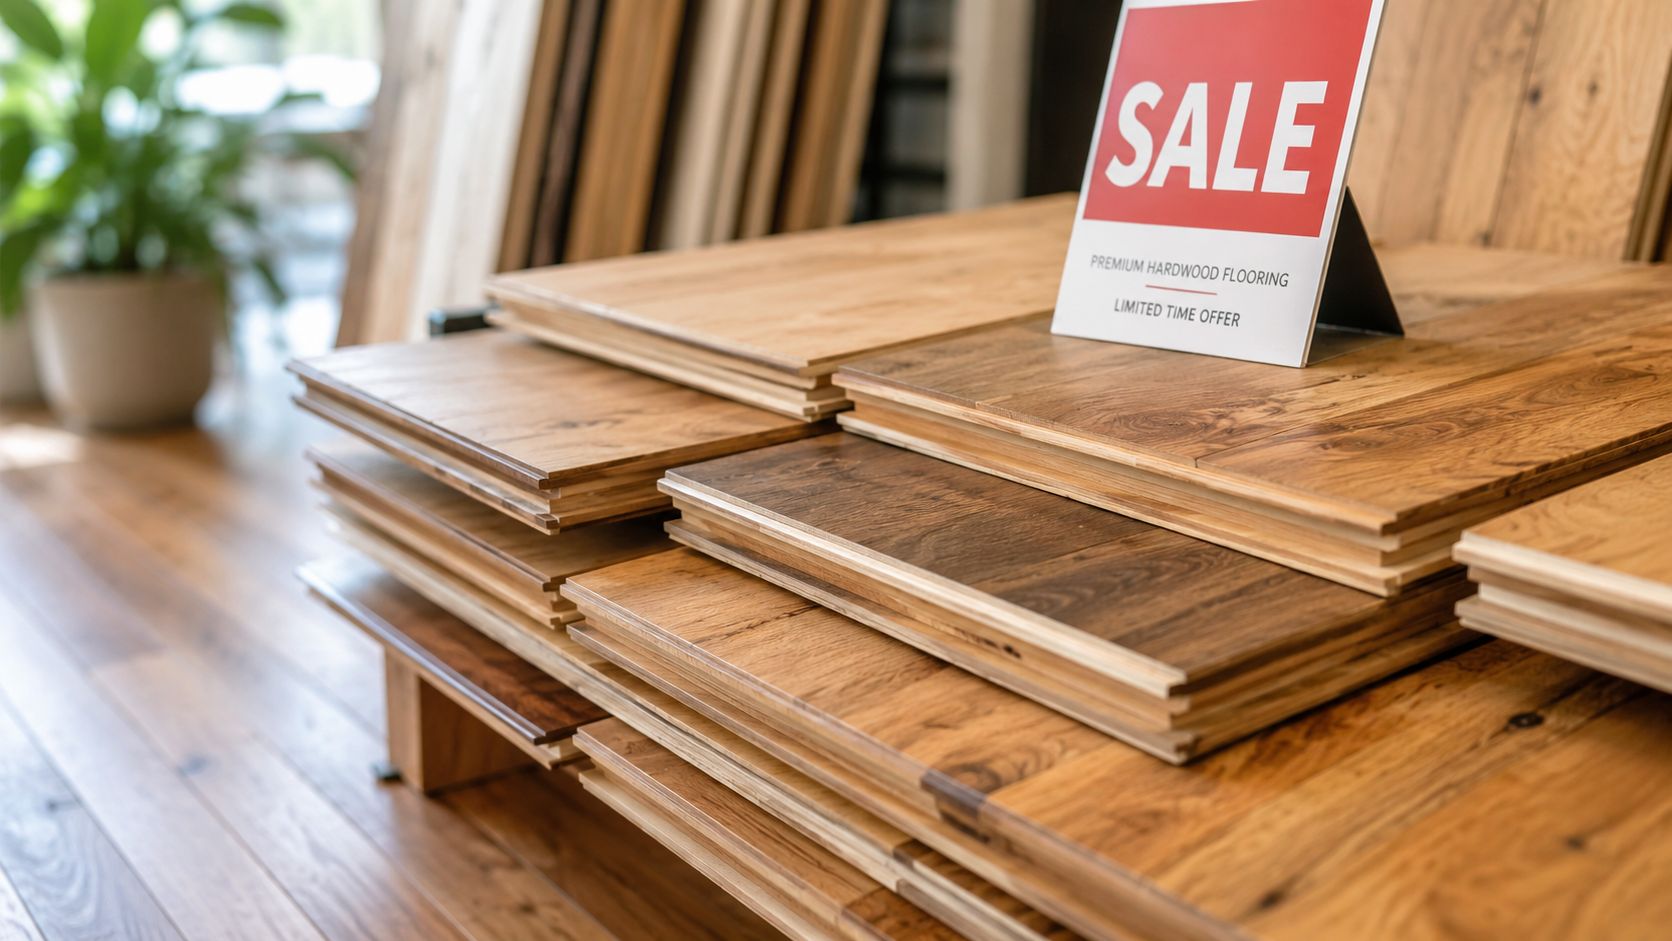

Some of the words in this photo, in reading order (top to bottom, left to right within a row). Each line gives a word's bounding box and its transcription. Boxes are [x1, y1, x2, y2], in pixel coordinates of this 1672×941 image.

[1105, 80, 1329, 195] SALE
[1090, 254, 1144, 273] PREMIUM
[1146, 260, 1219, 280] HARDWOOD
[1222, 267, 1289, 287] FLOORING
[1114, 298, 1162, 317] LIMITED
[1166, 304, 1196, 321] TIME
[1200, 308, 1241, 327] OFFER
